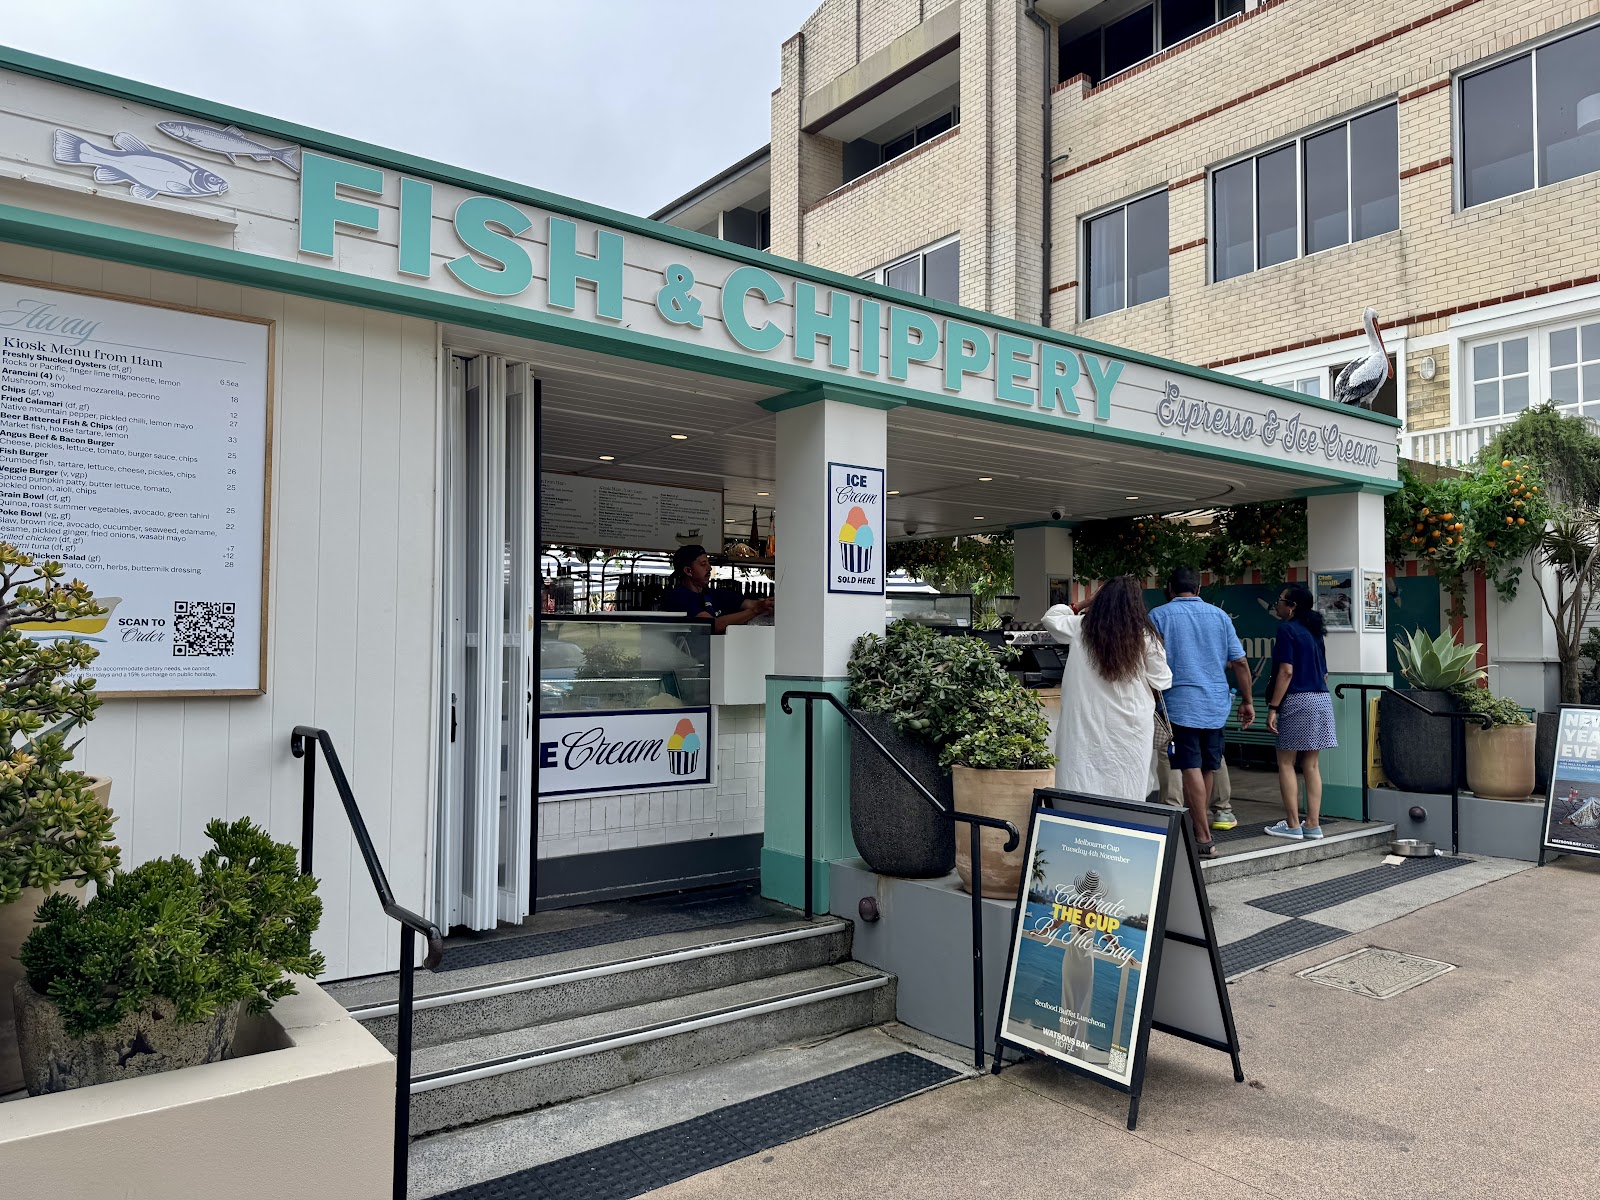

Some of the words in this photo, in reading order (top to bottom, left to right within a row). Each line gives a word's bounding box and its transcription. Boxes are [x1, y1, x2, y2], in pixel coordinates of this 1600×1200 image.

[299, 151, 624, 321] FISH
[656, 263, 704, 329] &
[721, 266, 1126, 420] CHIPPERY
[0, 299, 102, 346] Away
[2, 350, 34, 361] Freshly
[37, 354, 73, 365] Shucked
[74, 359, 106, 369] Oysters
[108, 363, 121, 372] (df,
[3, 337, 47, 352] Kiosk
[50, 343, 90, 358] Menu
[94, 350, 127, 363] from
[131, 355, 163, 368] 11am
[2, 358, 27, 366] Rocks
[70, 366, 92, 375] finger
[158, 378, 181, 386] lemon
[2, 368, 38, 378] Arancini
[40, 372, 53, 381] (4)
[55, 374, 65, 382] (v)
[1, 385, 26, 395] Chips
[28, 388, 41, 397] (gf,
[2, 376, 48, 388] Mushroom,
[50, 383, 82, 391] smoked
[84, 387, 126, 398] mozzarella,
[1, 394, 23, 403] Fried
[25, 397, 63, 407] Calamari
[65, 401, 78, 410] (df,
[0, 403, 26, 411] Native
[29, 407, 67, 416] mountain
[100, 414, 127, 422] pickled
[150, 419, 173, 427] lemon
[0, 412, 21, 421] Beer
[23, 415, 60, 425] Battered
[90, 422, 113, 431] Chips
[115, 424, 128, 433] (df)
[1156, 380, 1258, 435] Espresso
[1259, 409, 1280, 446] &
[1281, 413, 1317, 453] Ice
[1320, 423, 1380, 467] Cream
[0, 421, 29, 429] Market
[31, 424, 47, 432] fish,
[50, 426, 74, 434] house
[105, 431, 129, 439] lemon
[0, 430, 27, 438] Angus
[59, 435, 85, 444] Bacon
[87, 438, 115, 447] Burger
[20, 449, 48, 458] Burger
[66, 444, 96, 454] lettuce,
[97, 447, 126, 456] tomato,
[128, 450, 152, 458] burger
[154, 453, 177, 461] sauce,
[179, 455, 198, 463] chips
[30, 467, 58, 476] Burger
[40, 459, 56, 467] fish,
[58, 461, 86, 470] tartare,
[87, 463, 116, 472] lettuce,
[117, 466, 147, 475] cheese,
[148, 469, 176, 477] pickles,
[114, 483, 142, 492] lettuce,
[144, 485, 172, 494] tomato,
[847, 474, 867, 487] ICE
[46, 494, 58, 502] (df,
[836, 486, 877, 504] Cream
[88, 506, 132, 515] vegetables,
[133, 509, 166, 517] avocado,
[102, 524, 142, 532] cucumber,
[144, 526, 178, 534] seaweed,
[170, 566, 202, 575] dressing
[838, 576, 856, 584] SOLD
[118, 618, 148, 626] SCAN
[152, 618, 166, 626] TO
[120, 627, 165, 643] Order
[561, 727, 663, 770] Cream
[1562, 744, 1598, 759] EVE
[1061, 844, 1087, 856] Tuesday
[1088, 849, 1098, 857] 4th
[1099, 852, 1130, 864] November
[1074, 838, 1106, 850] Melbourne
[1107, 843, 1120, 852] Cup
[1055, 884, 1125, 918] Celebrate
[1052, 903, 1082, 925] THE
[1085, 911, 1120, 933] CUP
[1032, 918, 1063, 947] By
[1061, 925, 1094, 950] The
[1093, 934, 1136, 969] Bay
[1034, 998, 1057, 1012] Seafood
[1059, 1006, 1076, 1019] Buffet
[1077, 1013, 1106, 1028] Luncheon
[1042, 1027, 1075, 1046] WATSONS
[1076, 1040, 1090, 1051] BAY
[1055, 1040, 1074, 1052] HOTEL
